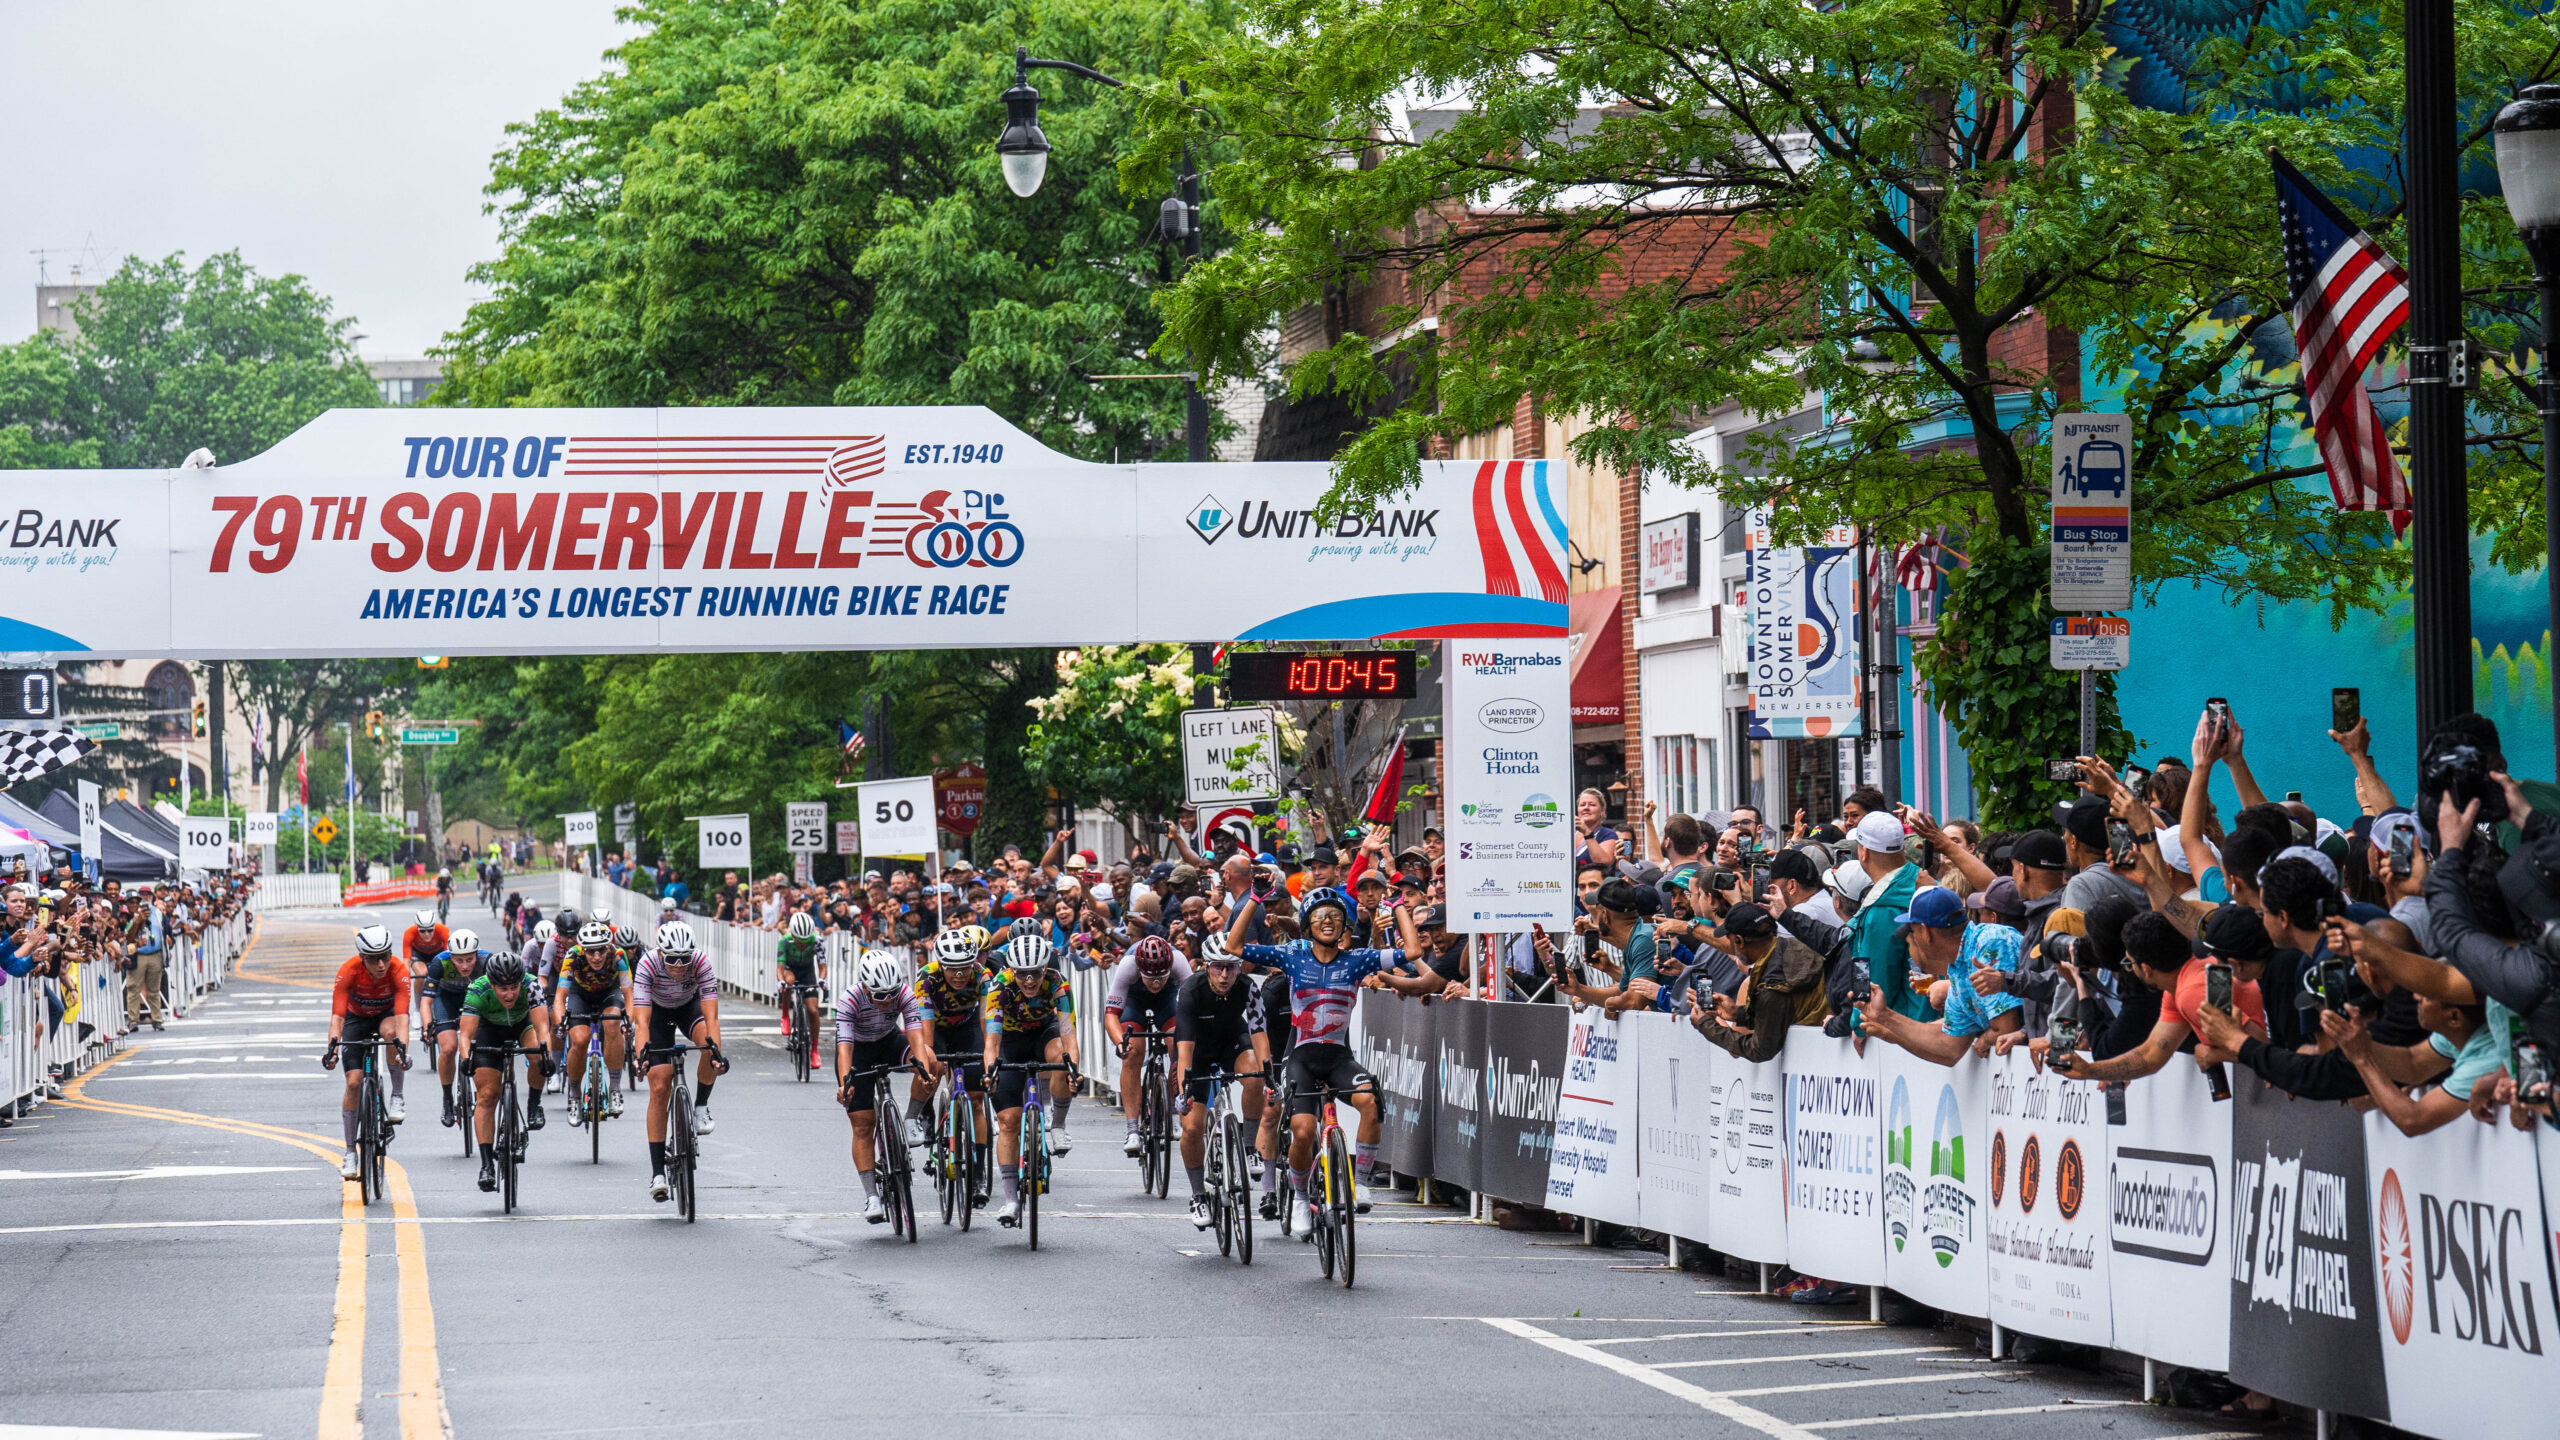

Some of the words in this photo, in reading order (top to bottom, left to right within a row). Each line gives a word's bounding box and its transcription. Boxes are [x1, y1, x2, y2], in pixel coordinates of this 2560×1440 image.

[2077, 424, 2120, 433] TRANSIT
[404, 436, 505, 479] TOUR
[513, 436, 567, 478] OF
[904, 443, 1003, 464] EST.1940
[209, 494, 368, 573] 79TH
[370, 490, 874, 573] SOMERVILLE
[2064, 529, 2086, 540] Bus
[2090, 529, 2119, 541] Stop
[46, 548, 77, 566] with
[80, 547, 118, 573] you!
[1308, 542, 1363, 562] growing
[1369, 538, 1399, 555] with
[1401, 537, 1438, 562] you!
[2063, 545, 2085, 553] Board
[2087, 545, 2104, 553] Here
[2106, 545, 2118, 553] For
[360, 587, 542, 619] AMERICA'S
[548, 586, 692, 618] LONGEST
[696, 585, 840, 617] RUNNING
[846, 584, 919, 616] BIKE
[927, 584, 1010, 616] RACE
[1757, 548, 1773, 698] DOWNTOWN
[1289, 658, 1396, 692] 1:00:45
[1475, 667, 1517, 675] HEALTH
[23, 674, 49, 714] 0
[1760, 703, 1789, 711] NEW
[1796, 701, 1853, 711] JERSEY
[1191, 722, 1223, 737] LEFT
[1232, 720, 1267, 735] LANE
[1483, 748, 1538, 760] Clinton
[1486, 762, 1540, 774] Honda
[1194, 776, 1229, 791] TURN
[947, 789, 984, 802] Parkin
[85, 802, 94, 826] 50
[791, 809, 823, 817] SPEED
[876, 800, 914, 823] 50
[249, 822, 274, 831] 200
[569, 821, 593, 832] 200
[791, 829, 823, 846] 25
[187, 831, 222, 847] 100
[706, 831, 742, 847] 100
[1476, 842, 1514, 850] Somerset
[1517, 841, 1548, 851] County
[1476, 852, 1513, 860] Business
[1515, 851, 1566, 861] Partnership
[1524, 881, 1543, 889] LONG
[1546, 881, 1561, 889] TAIL
[1570, 1059, 1597, 1083] HEALTH
[1799, 1074, 1875, 1118] DOWNTOWN
[1576, 1115, 1596, 1141] Wood
[1597, 1117, 1617, 1146] Johnson
[1797, 1128, 1873, 1175] SOMERVILLE
[1582, 1148, 1609, 1178] Hospital
[1797, 1182, 1815, 1210] NEW
[1818, 1185, 1874, 1217] JERSEY
[2300, 1168, 2348, 1241] KUSTOM
[2046, 1228, 2095, 1270] Handmade
[2294, 1244, 2357, 1321] APPAREL
[2420, 1193, 2544, 1357] PSEG
[2055, 1281, 2082, 1300] VODKA
